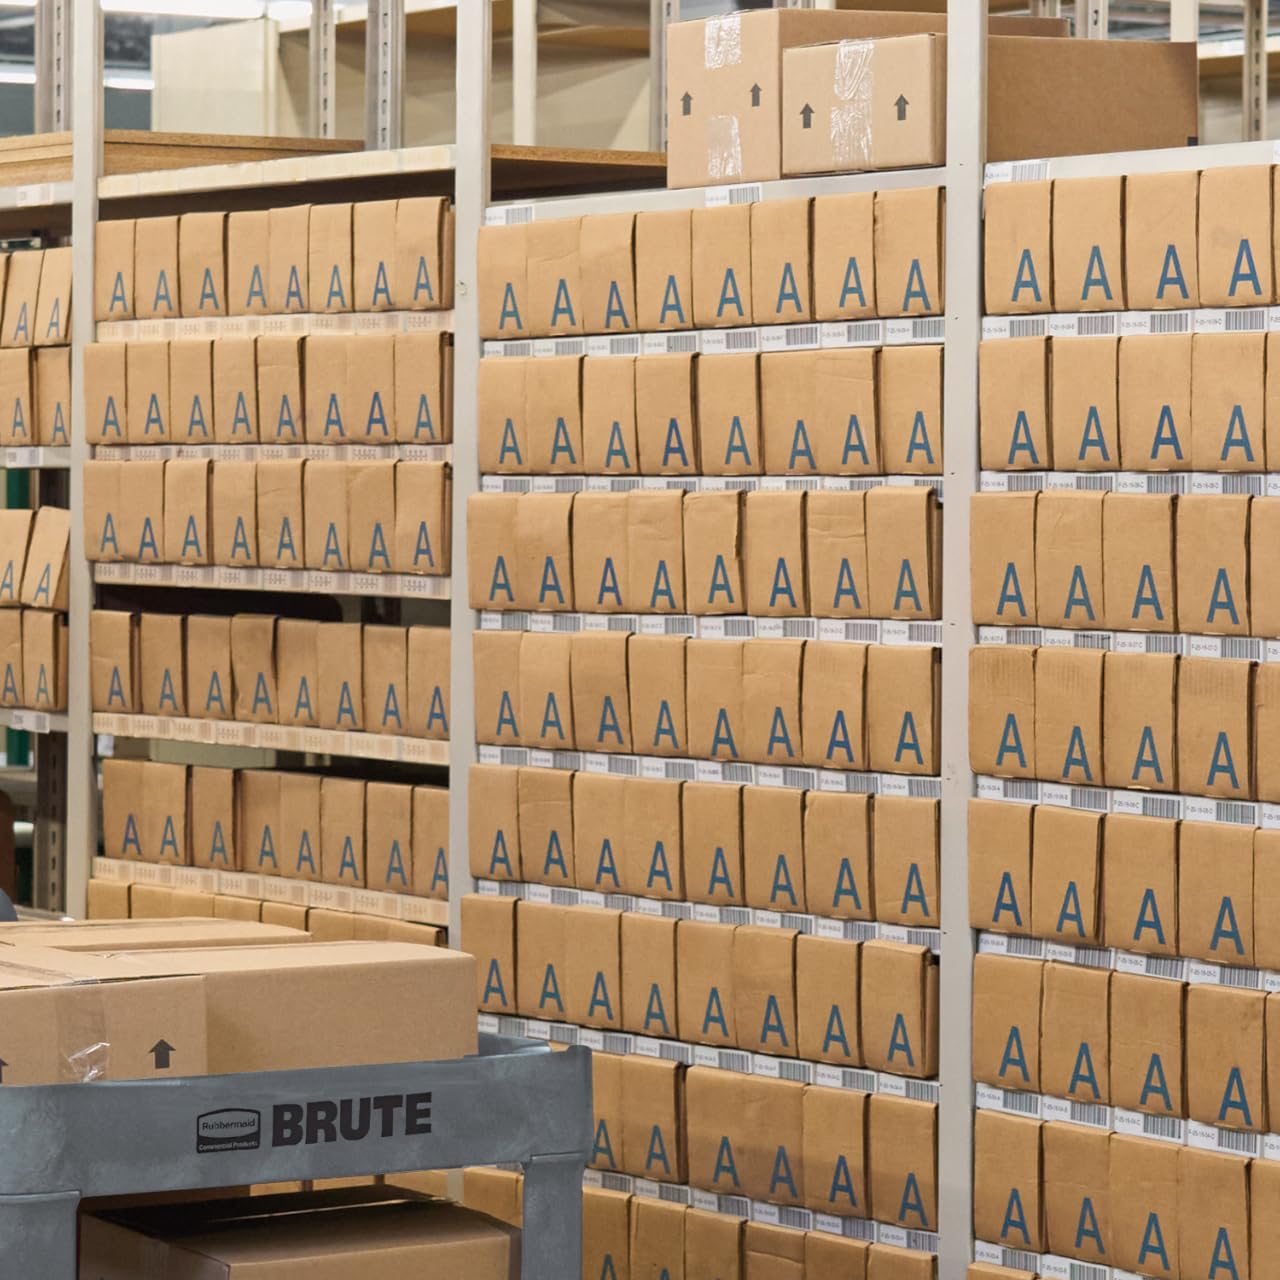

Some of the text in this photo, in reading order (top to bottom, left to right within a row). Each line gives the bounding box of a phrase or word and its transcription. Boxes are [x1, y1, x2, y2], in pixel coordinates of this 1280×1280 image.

[111, 272, 128, 310] A
[201, 269, 219, 308] A
[246, 266, 266, 306] A
[327, 266, 346, 306] A
[373, 262, 391, 304] A
[414, 256, 432, 299] A
[777, 264, 801, 313] A
[903, 260, 930, 310] A
[1012, 249, 1040, 301] A
[1082, 246, 1112, 300] A
[1157, 245, 1188, 299] A
[1229, 240, 1261, 296] A
[500, 283, 522, 329] A
[551, 279, 576, 325] A
[606, 282, 628, 327] A
[717, 268, 743, 317] A
[14, 302, 28, 341] A
[47, 297, 60, 339] A
[12, 397, 27, 438] A
[52, 401, 68, 443] A
[103, 397, 121, 434] A
[188, 395, 208, 435] A
[233, 393, 250, 433] A
[277, 396, 296, 435] A
[367, 392, 388, 435] A
[416, 395, 434, 437] A
[1079, 406, 1109, 460] A
[1152, 405, 1182, 459] A
[1222, 405, 1254, 461] A
[500, 420, 522, 464] A
[551, 417, 575, 464] A
[663, 419, 688, 466] A
[726, 416, 751, 464] A
[789, 420, 816, 468] A
[907, 412, 934, 464] A
[1008, 411, 1038, 464] A
[102, 513, 118, 551] A
[182, 516, 201, 556] A
[232, 518, 250, 560] A
[278, 518, 296, 559] A
[369, 523, 389, 566] A
[414, 522, 433, 565] A
[0, 559, 14, 600] A
[35, 562, 51, 604] A
[540, 556, 564, 603] A
[599, 559, 621, 605] A
[709, 555, 733, 603] A
[770, 557, 796, 608] A
[834, 560, 860, 608] A
[997, 563, 1025, 616] A
[1065, 565, 1094, 619] A
[1133, 565, 1163, 620] A
[1208, 568, 1238, 624] A
[3, 662, 18, 703] A
[37, 663, 50, 703] A
[108, 668, 125, 704] A
[207, 672, 224, 711] A
[253, 672, 272, 713] A
[296, 677, 312, 719] A
[384, 684, 401, 725] A
[428, 688, 448, 731] A
[496, 691, 518, 736] A
[541, 693, 563, 739] A
[598, 697, 622, 744] A
[711, 709, 737, 757] A
[768, 708, 794, 757] A
[827, 711, 853, 762] A
[996, 714, 1026, 768] A
[1063, 726, 1092, 781] A
[1132, 727, 1163, 783] A
[1208, 732, 1239, 788] A
[160, 816, 177, 853] A
[211, 822, 227, 864] A
[259, 826, 276, 865] A
[490, 832, 511, 875] A
[544, 832, 567, 876] A
[340, 837, 358, 880] A
[387, 841, 407, 884] A
[431, 848, 449, 892] A
[596, 839, 619, 886] A
[709, 848, 733, 896] A
[771, 855, 797, 905] A
[833, 858, 861, 909] A
[993, 872, 1021, 925] A
[1056, 881, 1085, 936] A
[1134, 889, 1165, 944] A
[1211, 896, 1244, 955] A
[540, 964, 563, 1012] A
[589, 972, 612, 1019] A
[644, 984, 668, 1032] A
[761, 996, 787, 1046] A
[823, 1005, 850, 1056] A
[888, 1014, 913, 1065] A
[999, 1027, 1029, 1082] A
[1069, 1043, 1099, 1099] A
[1140, 1054, 1172, 1110] A
[1219, 1068, 1252, 1126] A
[202, 1117, 256, 1131] Rubbermaid
[272, 1092, 432, 1147] BRUTE
[592, 1120, 616, 1170] A
[646, 1126, 670, 1173] A
[770, 1147, 797, 1197] A
[829, 1156, 857, 1207] A
[899, 1174, 927, 1226] A
[1001, 1189, 1029, 1243] A
[1075, 1197, 1104, 1254] A
[1138, 1213, 1169, 1270] A
